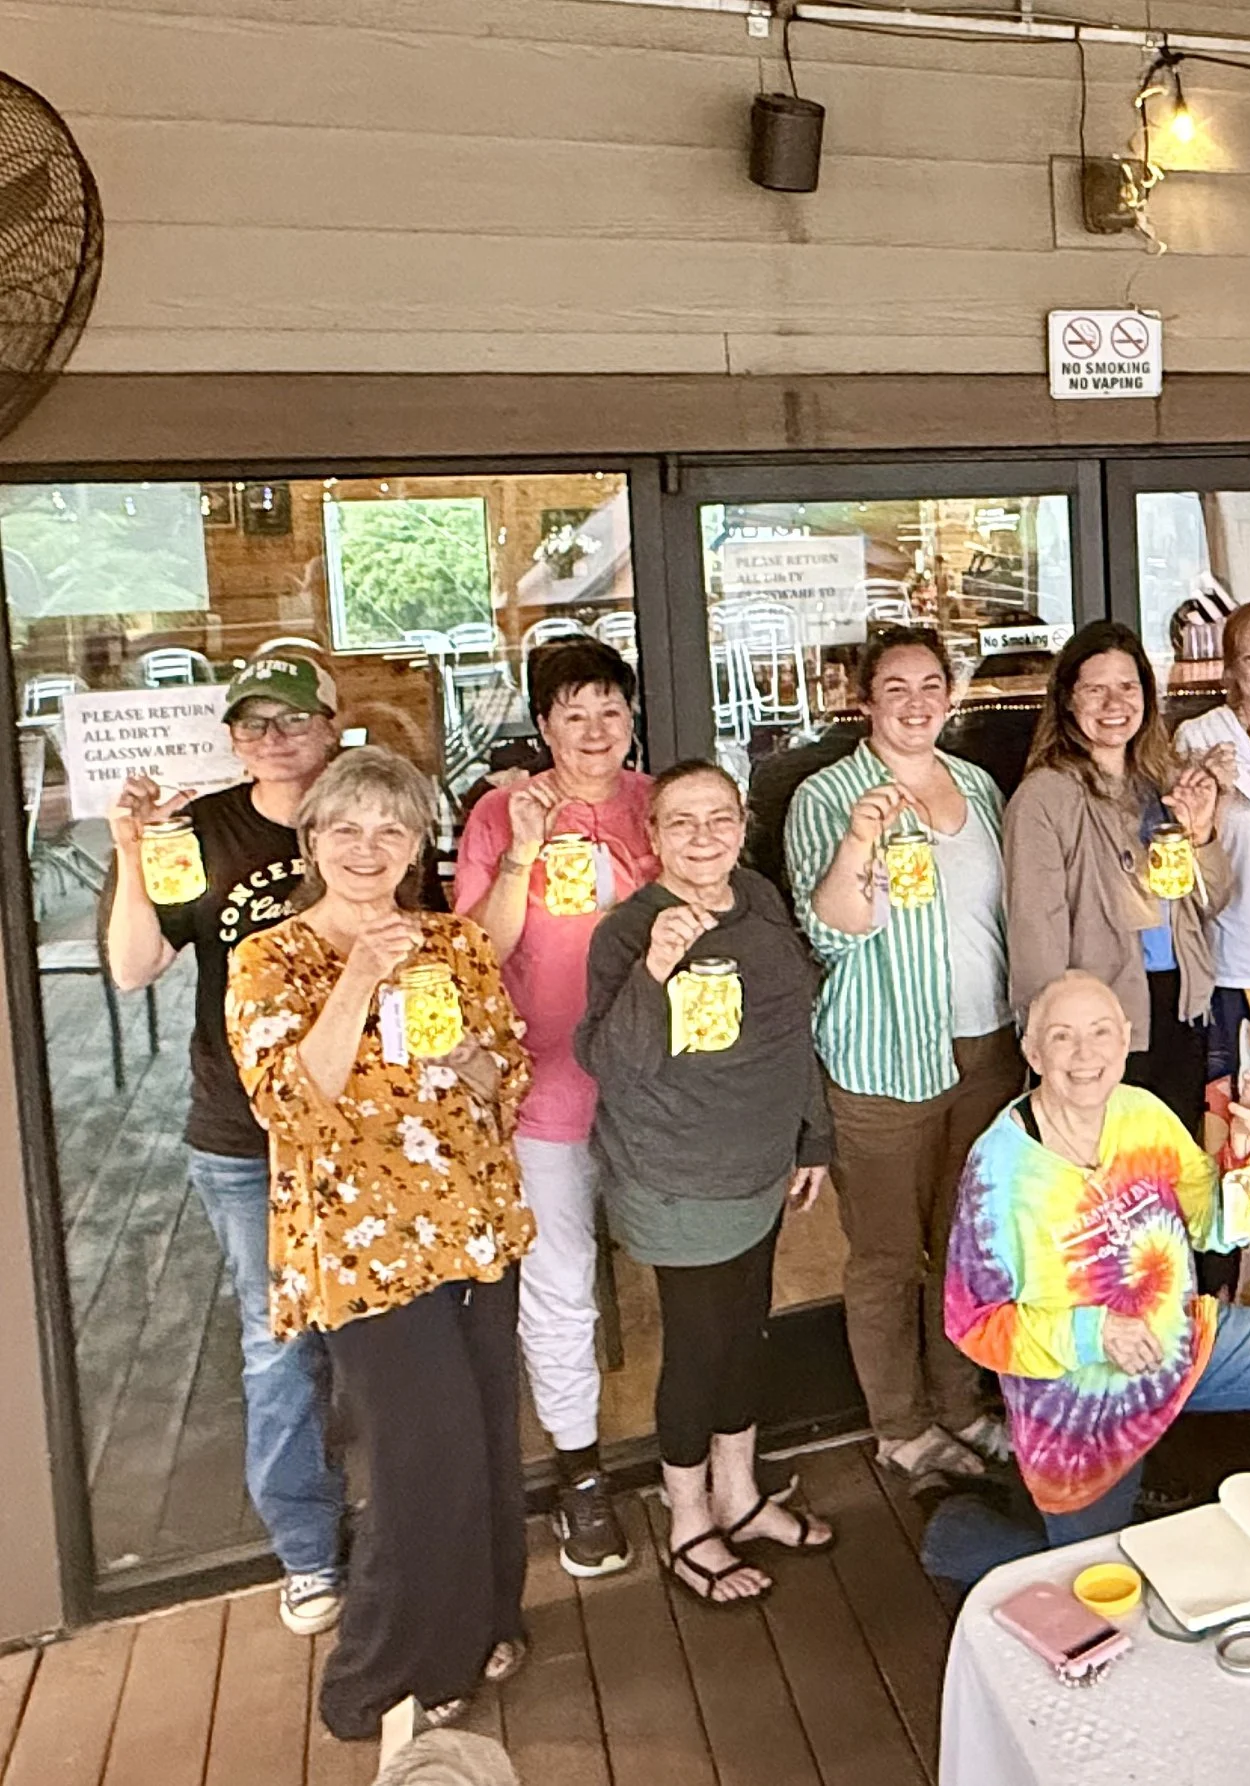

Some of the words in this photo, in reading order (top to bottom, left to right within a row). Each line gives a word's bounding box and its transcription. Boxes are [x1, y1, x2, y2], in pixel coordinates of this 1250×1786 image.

[1061, 361, 1081, 375] NO
[1085, 361, 1151, 375] SMOKING
[1068, 377, 1089, 390] NO
[1092, 376, 1144, 390] VAPING
[735, 555, 784, 568] PLEASE
[786, 553, 839, 565] RETURN
[736, 573, 762, 584] ALL
[983, 636, 999, 648] No
[1001, 631, 1049, 648] Smoking
[81, 708, 144, 724] PLEASE
[147, 703, 216, 720] RETURN
[84, 729, 116, 744] ALL
[119, 725, 172, 741] DIRTY
[84, 744, 188, 763] GLASSWARE
[190, 741, 214, 754] TO
[87, 767, 122, 782] THE
[219, 858, 306, 942] CONCER
